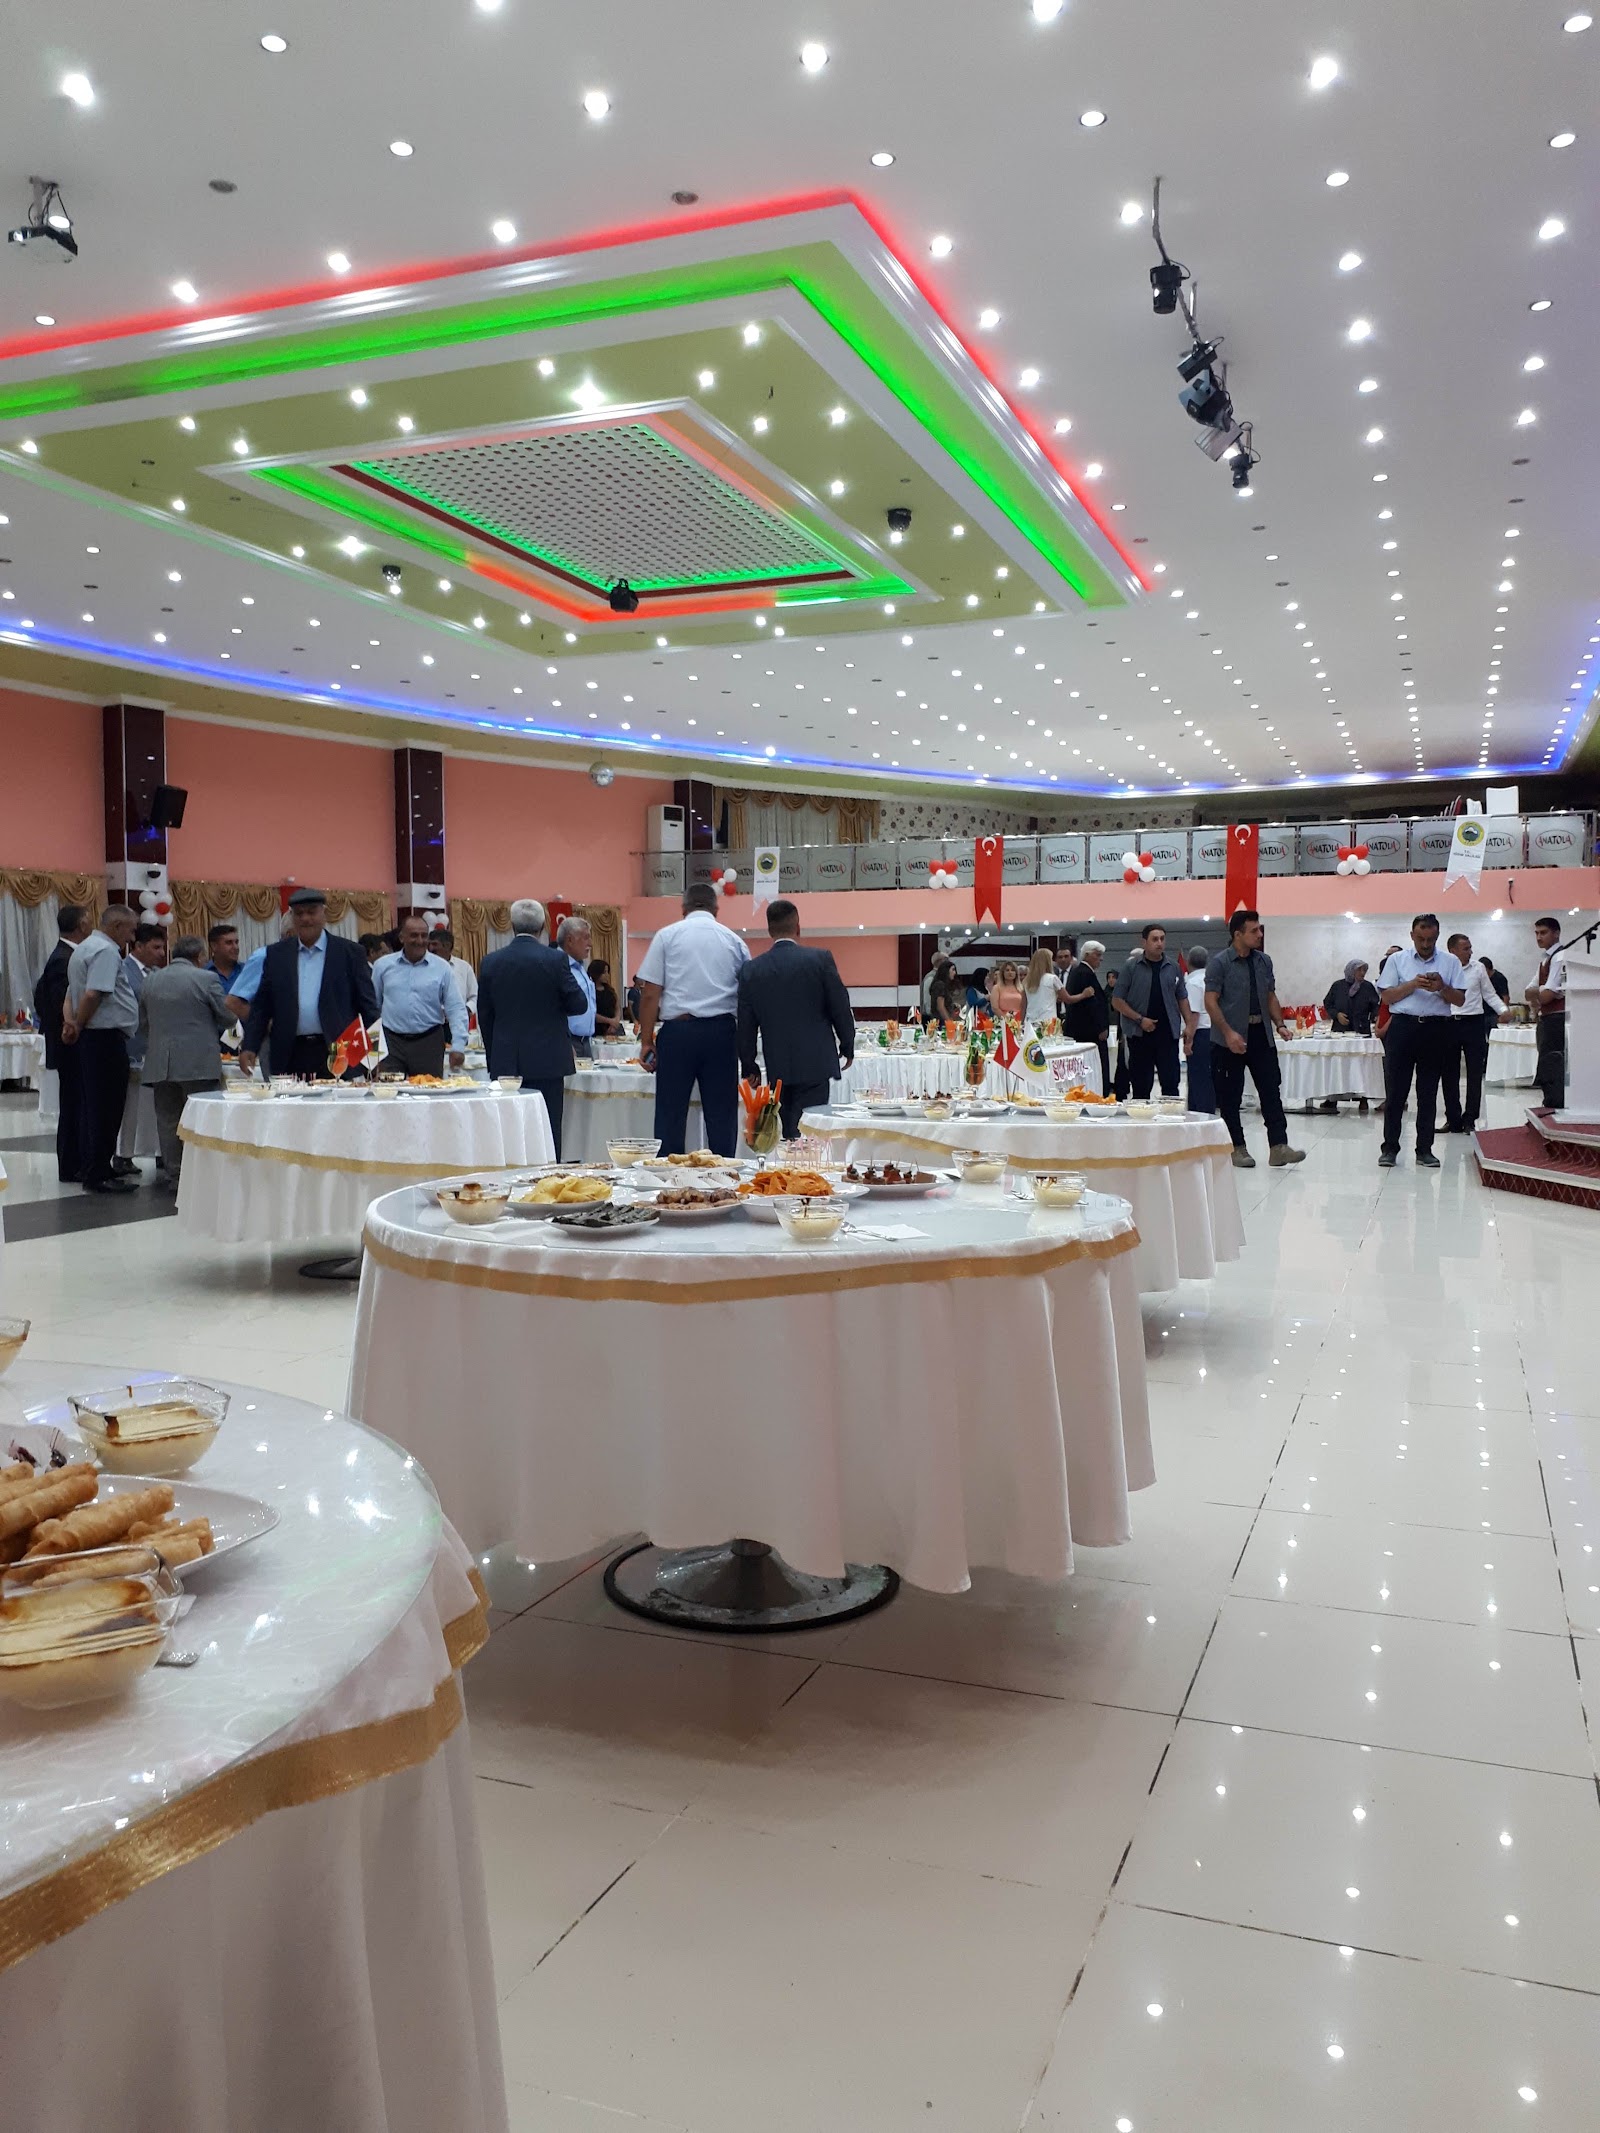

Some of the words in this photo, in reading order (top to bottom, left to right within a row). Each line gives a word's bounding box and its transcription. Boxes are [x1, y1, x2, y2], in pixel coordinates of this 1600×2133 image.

[1486, 837, 1513, 848] NATOLIA
[1098, 851, 1125, 863] ANATOLI
[1149, 849, 1178, 860] NATOLIA
[908, 860, 929, 871] ANATOL
[957, 859, 975, 868] NATOL
[1002, 856, 1028, 867] NATOLIA
[779, 866, 801, 875] NATOLIA
